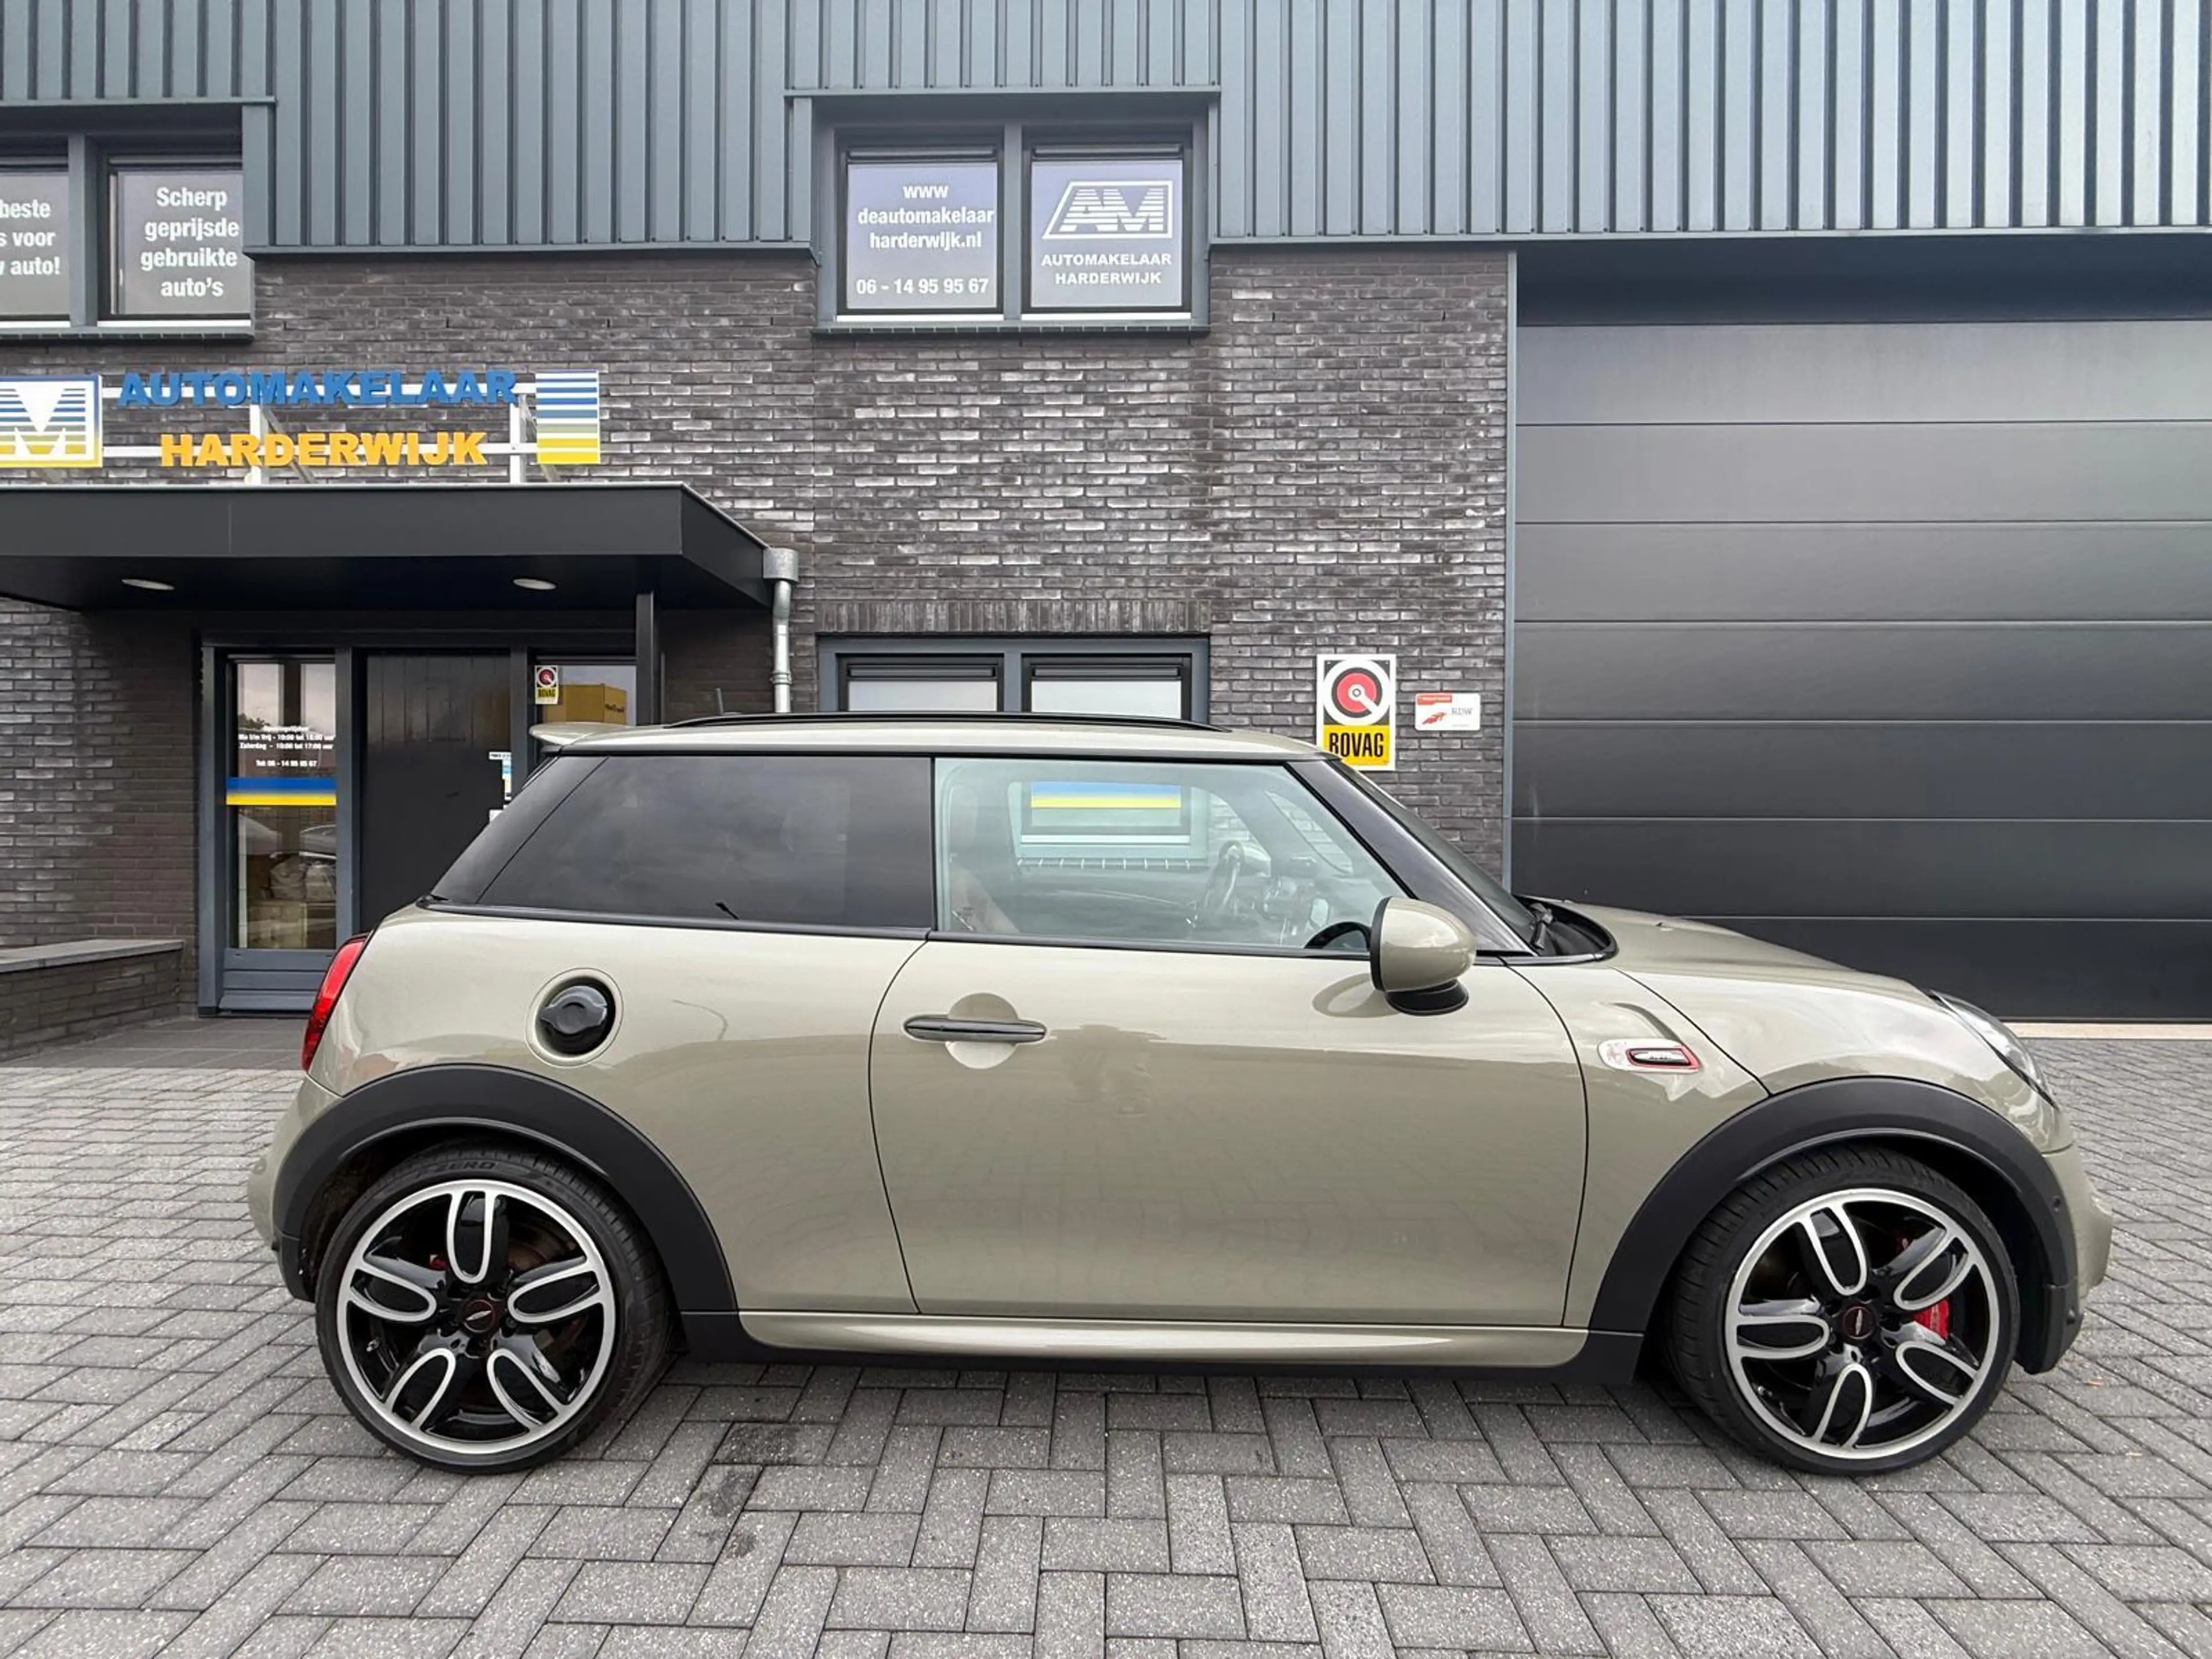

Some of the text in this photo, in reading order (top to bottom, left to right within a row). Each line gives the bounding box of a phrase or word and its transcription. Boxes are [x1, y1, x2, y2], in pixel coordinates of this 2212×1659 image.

[156, 187, 227, 211] Scherp
[903, 185, 949, 198] www
[0, 199, 51, 218] beste
[858, 207, 994, 224] deautomakelaar
[1059, 188, 1164, 232] AM
[144, 217, 240, 241] geprijsde
[12, 232, 56, 247] voor
[869, 232, 982, 250] harderwijk.nl
[10, 256, 60, 275] auto!
[141, 248, 237, 271] gebruikte
[1041, 253, 1172, 267] AUTOMAKELAAR
[161, 278, 224, 297] auto's
[856, 279, 877, 294] 06
[894, 279, 913, 294] 14
[918, 279, 938, 294] 95
[944, 279, 964, 294] 95
[968, 279, 989, 294] 67
[1055, 272, 1162, 285] HARDERWIJK
[117, 370, 518, 407] AUTOMAKELAAR
[160, 431, 487, 467] HARDERWIJK
[1329, 732, 1384, 757] ROVAG
